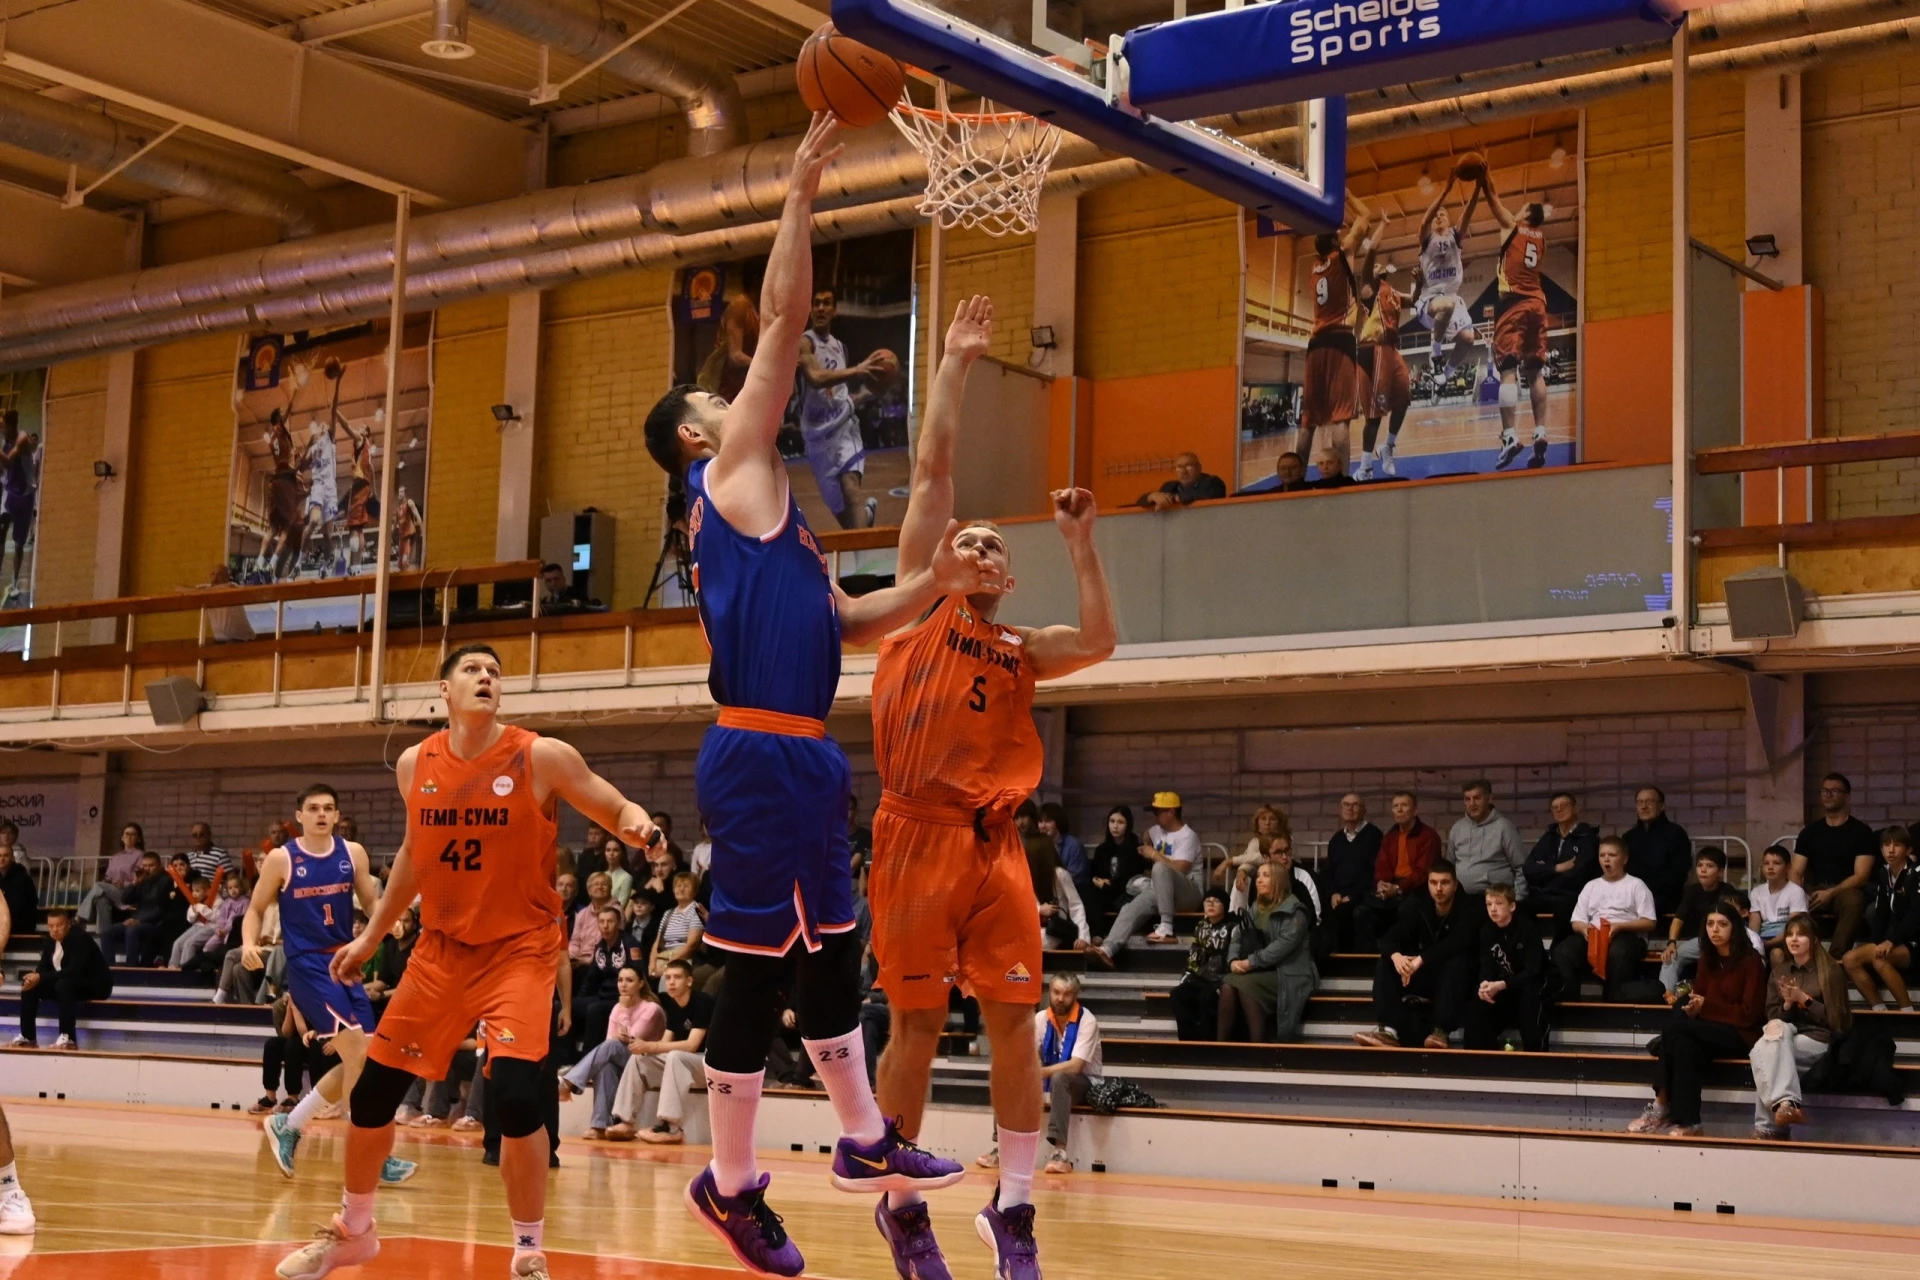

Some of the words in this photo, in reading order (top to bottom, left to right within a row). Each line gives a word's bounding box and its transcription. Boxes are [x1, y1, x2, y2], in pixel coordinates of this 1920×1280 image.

[1290, 16, 1441, 66] Sports
[1524, 241, 1538, 269] 5
[1316, 276, 1329, 306] 9
[969, 675, 987, 712] 5
[420, 807, 509, 827] ТЕМП-СУМЗ
[440, 838, 482, 872] 42
[323, 903, 335, 926] 1
[818, 1047, 849, 1062] 23
